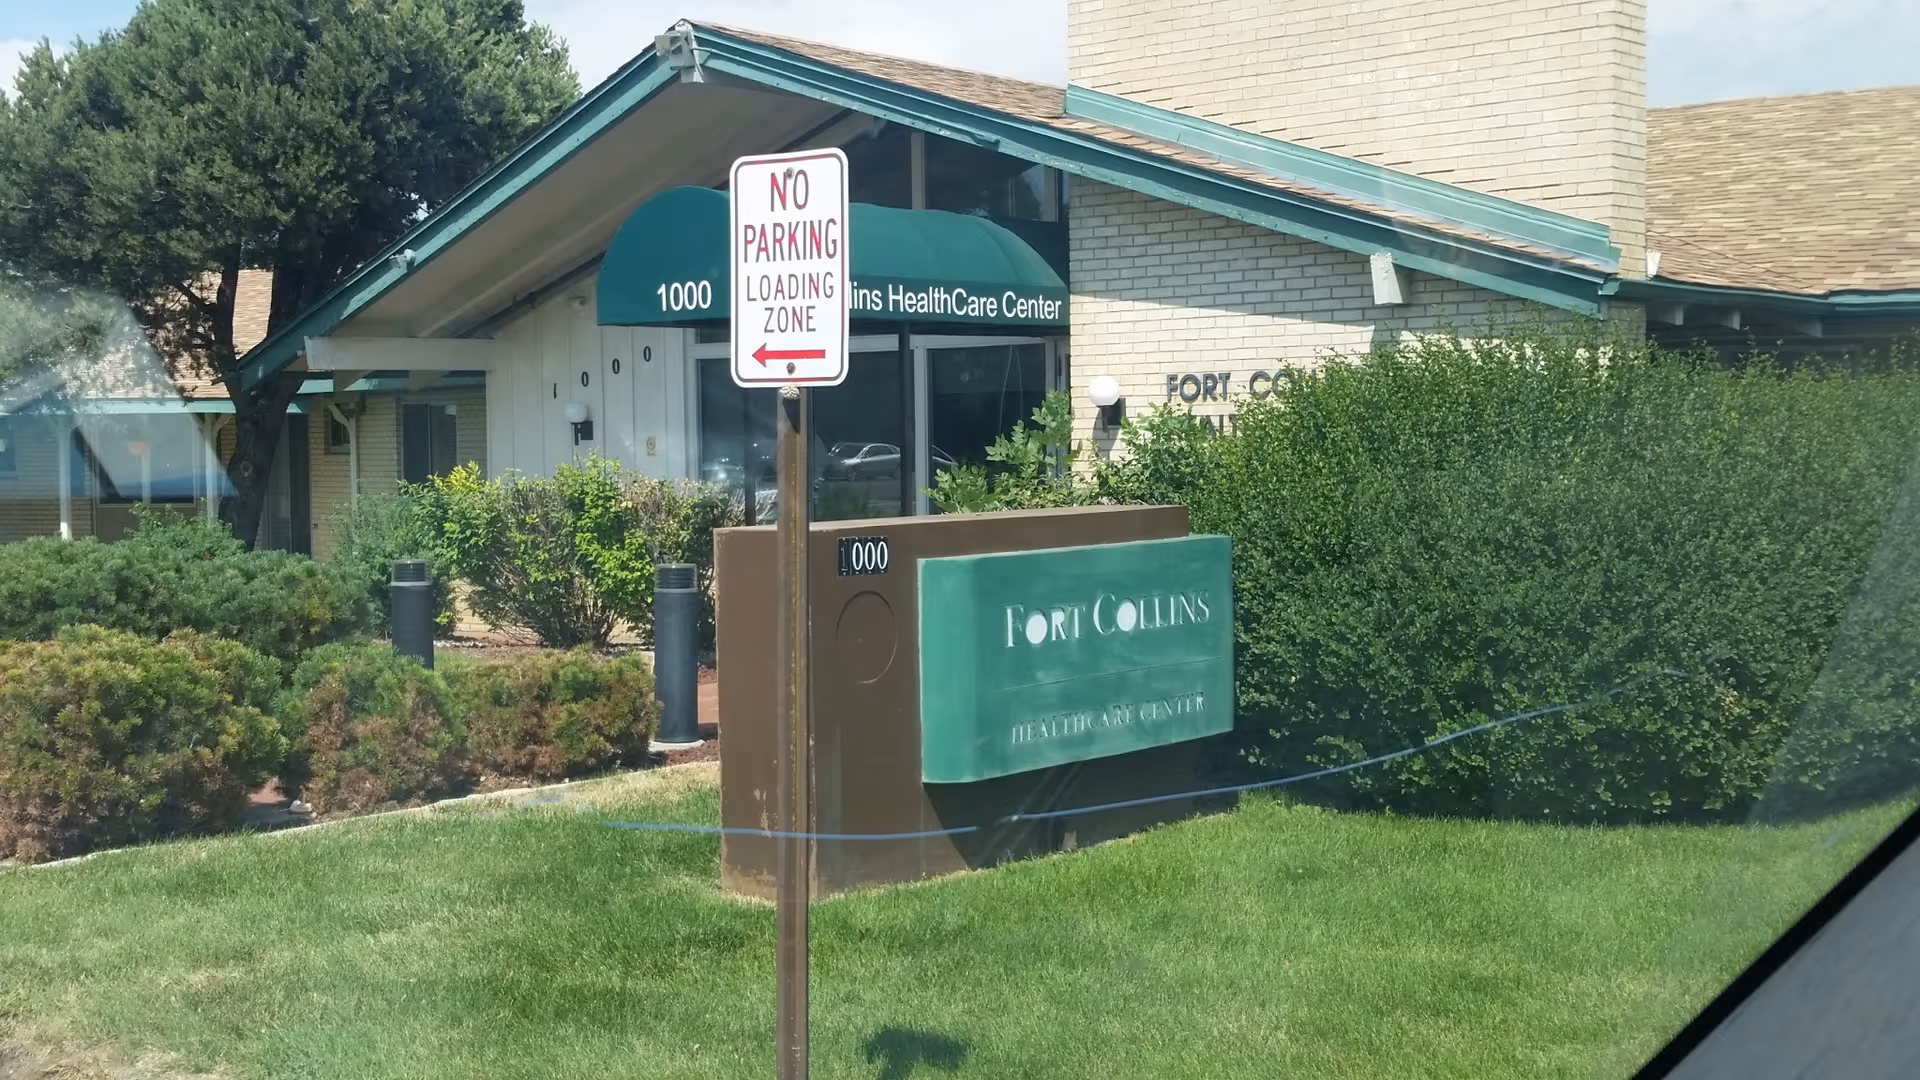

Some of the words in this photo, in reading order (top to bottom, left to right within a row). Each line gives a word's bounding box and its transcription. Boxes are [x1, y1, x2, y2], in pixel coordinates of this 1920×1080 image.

[770, 169, 809, 212] NO
[744, 218, 837, 263] PARKING
[657, 280, 712, 311] 1000
[888, 283, 998, 317] HealthCare
[1002, 291, 1062, 320] Center
[747, 272, 834, 302] LOADING
[764, 306, 816, 333] ZONE
[1166, 372, 1231, 403] FORT
[1004, 602, 1088, 648] FORT
[1093, 590, 1210, 635] COLLINS
[1012, 703, 1133, 743] HEALTHCARE
[1140, 691, 1206, 721] CENTER
